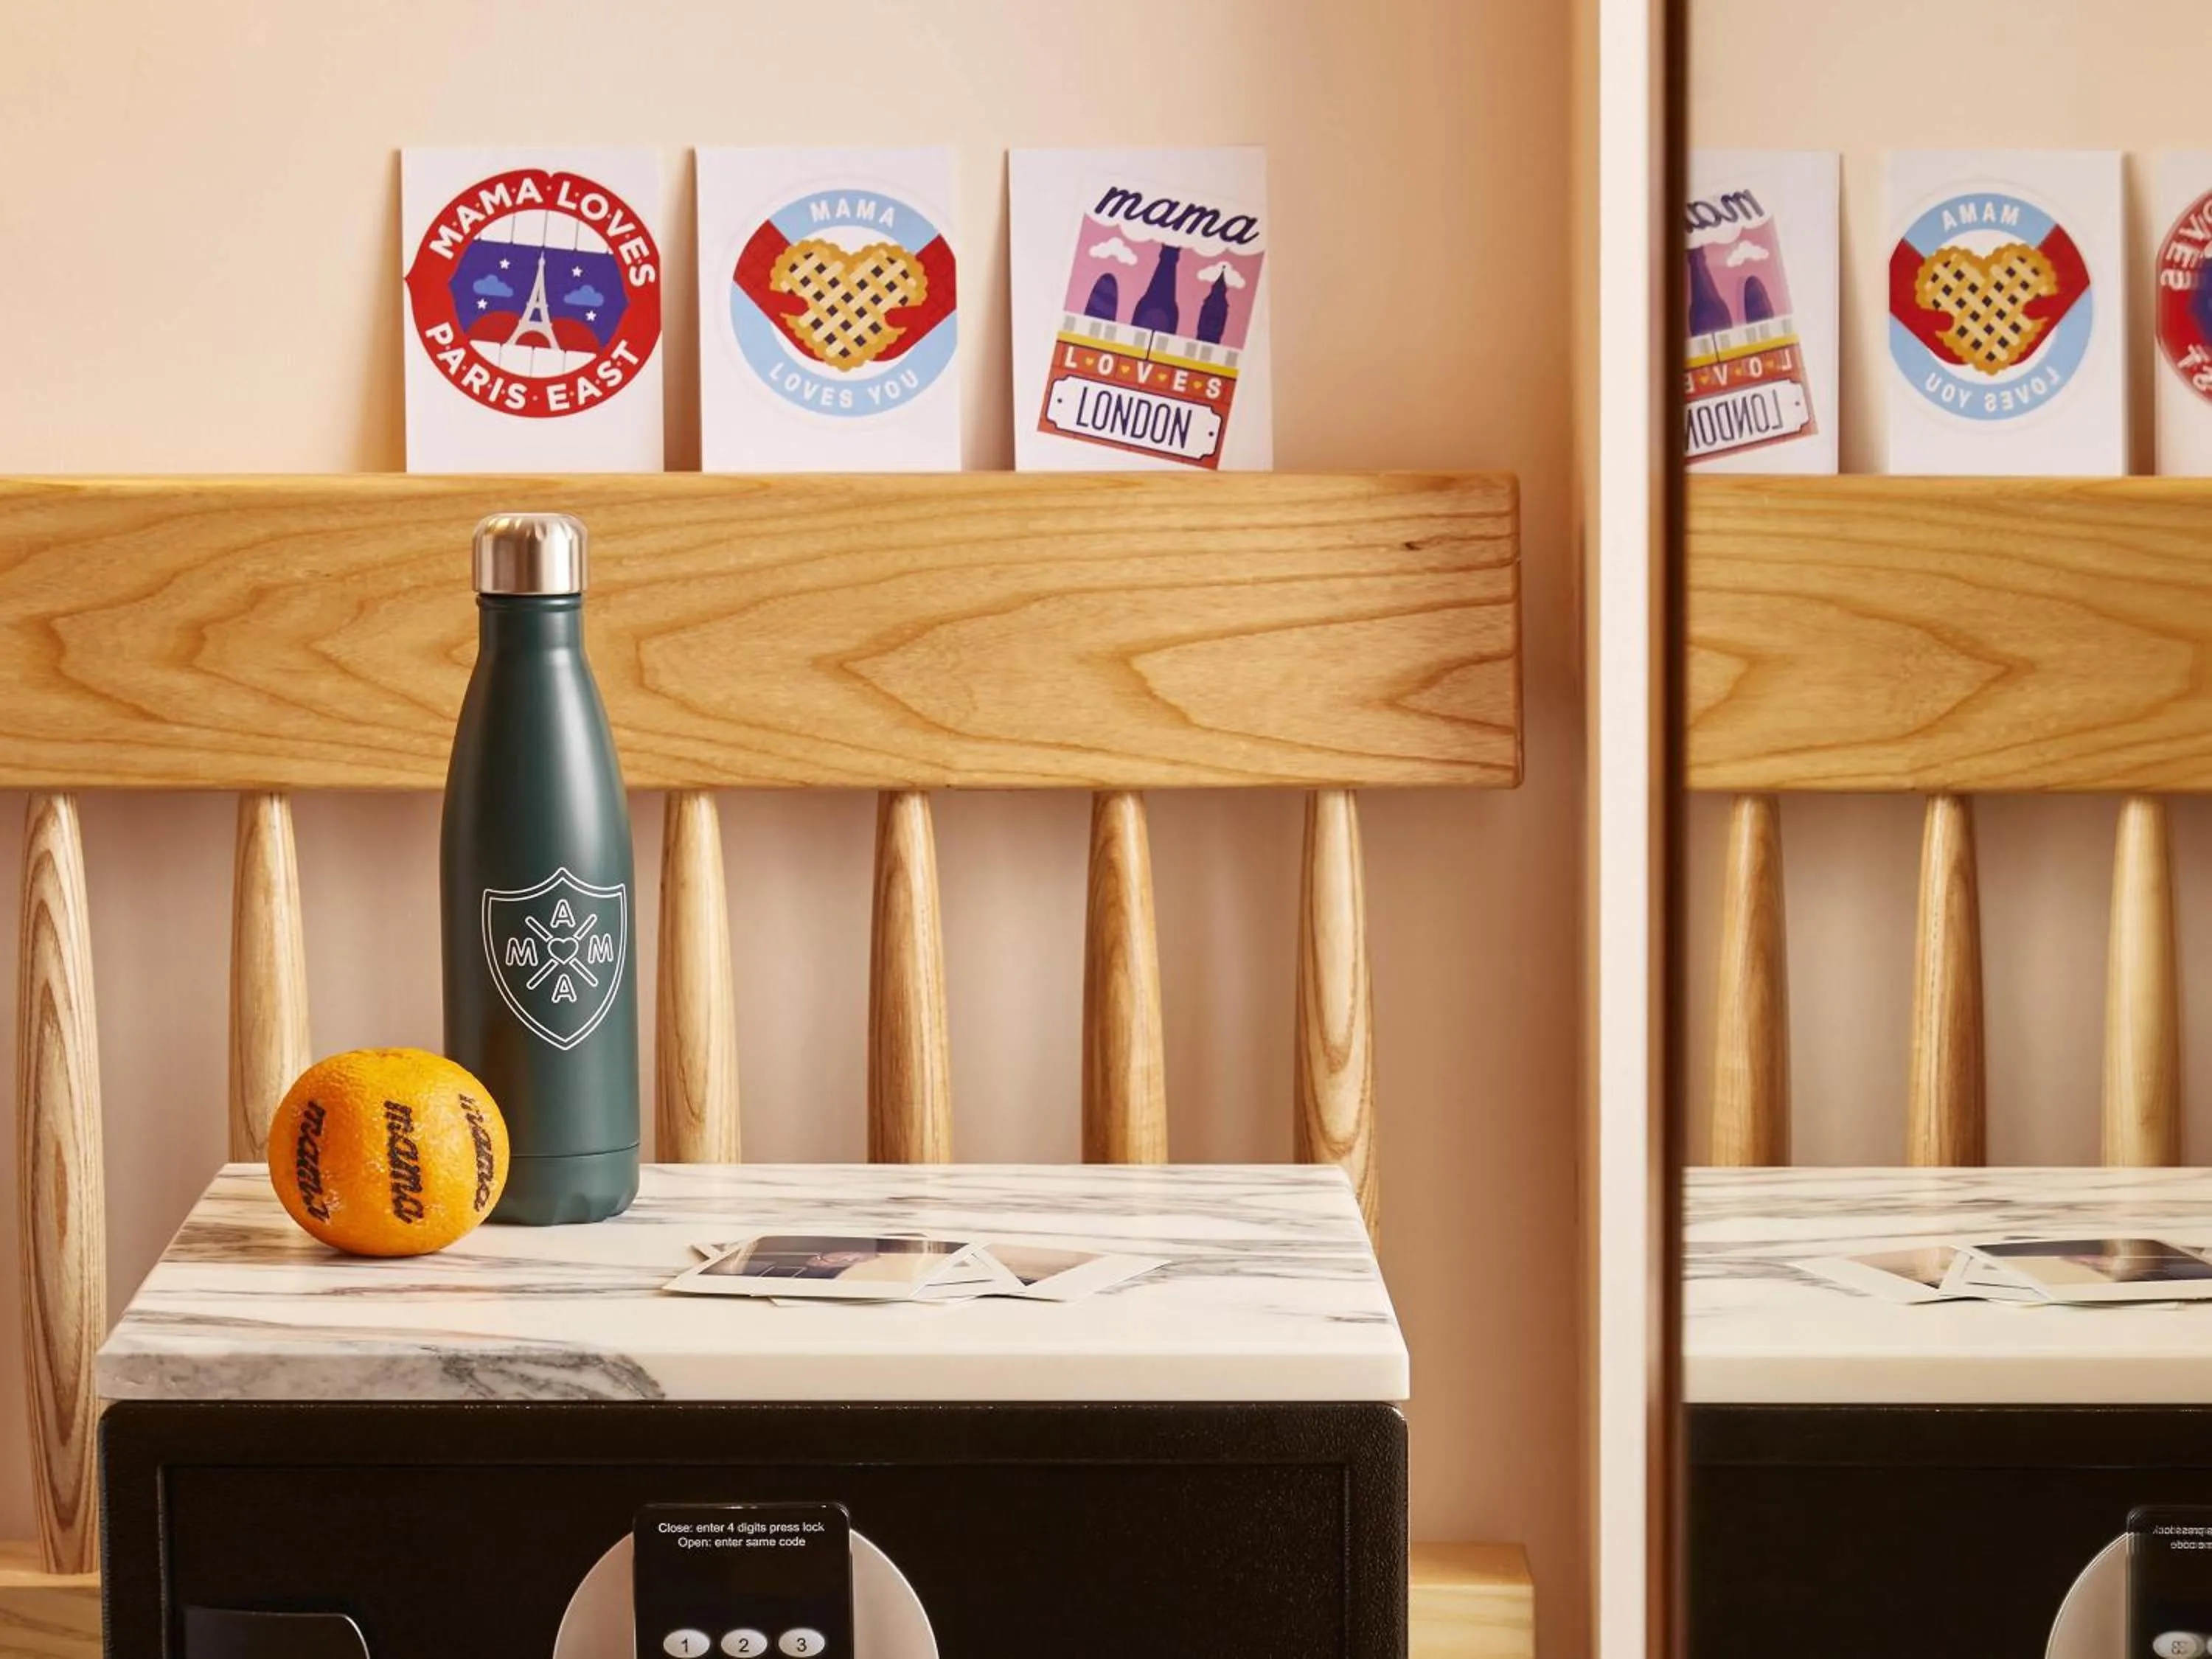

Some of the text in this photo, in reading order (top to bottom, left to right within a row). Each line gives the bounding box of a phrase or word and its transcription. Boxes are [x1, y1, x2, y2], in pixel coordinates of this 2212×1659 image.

[429, 177, 655, 288] MAMA LOVES
[810, 198, 897, 228] MAMA
[1094, 186, 1260, 246] mama
[425, 321, 639, 412] PARIS EAST
[769, 362, 919, 408] LOVES YOU
[1064, 345, 1222, 400] LOVES
[1076, 386, 1193, 450] LONDON
[383, 1100, 424, 1224] mama
[658, 1522, 825, 1534] Close: enter 4 digits press lock
[678, 1537, 806, 1548] Open: enter same code
[681, 1638, 807, 1652] 1 2 3
